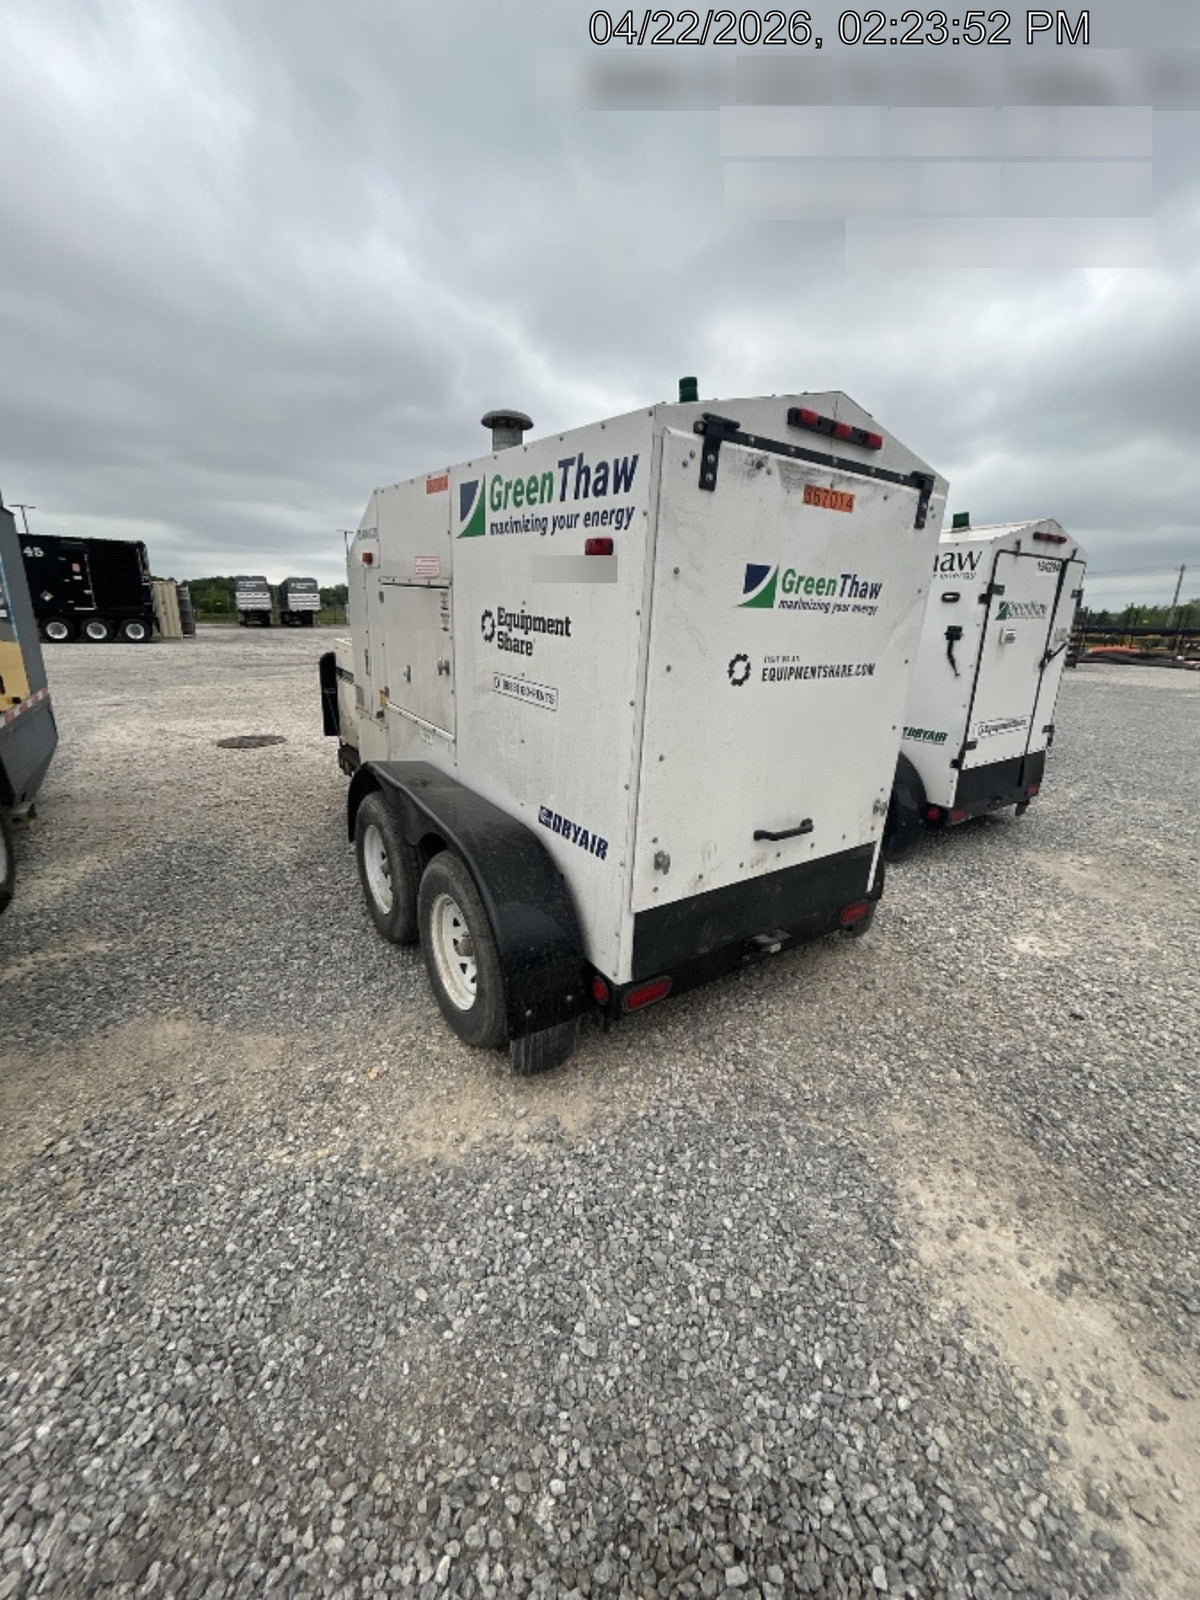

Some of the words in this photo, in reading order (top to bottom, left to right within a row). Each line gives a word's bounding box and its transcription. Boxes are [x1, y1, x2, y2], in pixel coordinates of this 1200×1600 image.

[490, 514, 548, 536] maximizing
[551, 512, 580, 535] your
[583, 506, 635, 530] energy
[497, 606, 571, 637] Equipment
[497, 631, 533, 656] Share
[762, 663, 876, 682] EQUIPMENTSHARE.COM
